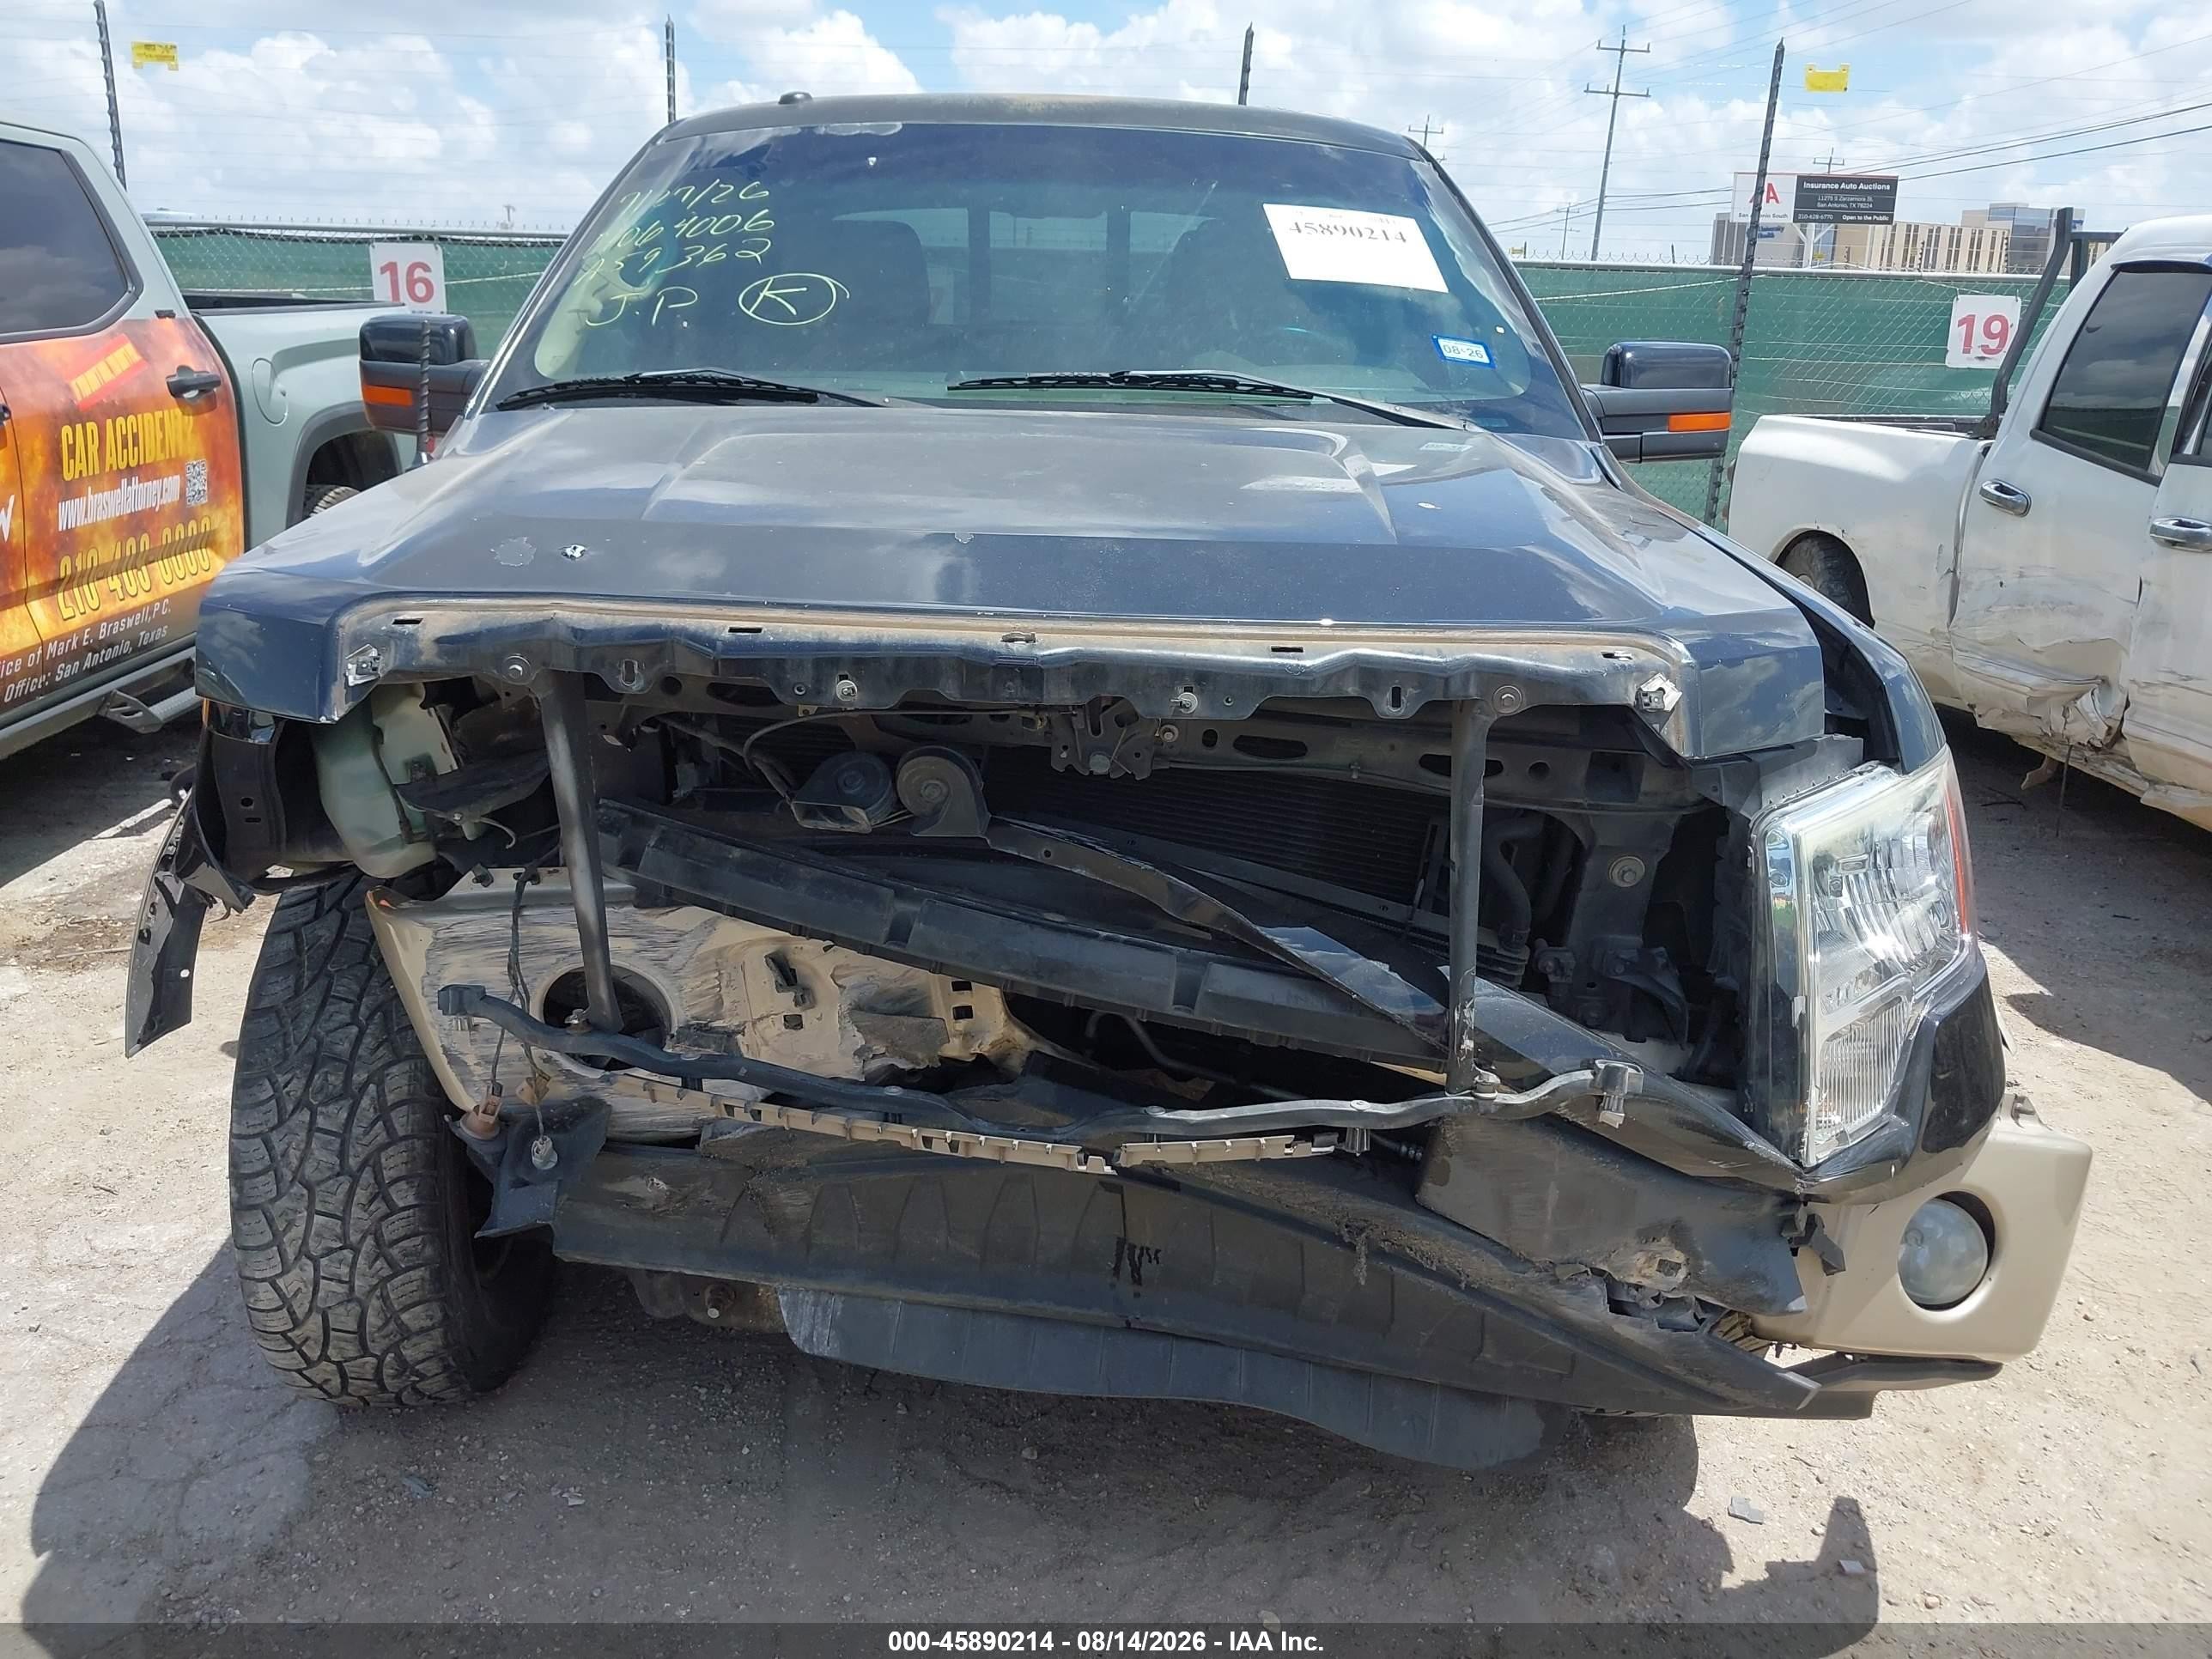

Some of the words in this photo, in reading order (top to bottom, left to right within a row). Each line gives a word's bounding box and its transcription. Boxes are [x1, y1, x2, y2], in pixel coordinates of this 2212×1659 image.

[1803, 181, 1839, 190] Insurance
[1858, 182, 1890, 191] Auctions
[1290, 222, 1407, 243] 45890214
[380, 261, 434, 303] 16
[1957, 314, 2009, 356] 19
[61, 421, 100, 481] CAR
[58, 475, 181, 532] www.braswellattorney.com
[4, 672, 52, 703] Office:
[55, 660, 80, 682] San
[82, 639, 133, 672] Antonio,
[137, 625, 168, 647] Texas
[27, 645, 43, 667] of
[46, 633, 79, 661] Mark
[82, 628, 94, 647] E.
